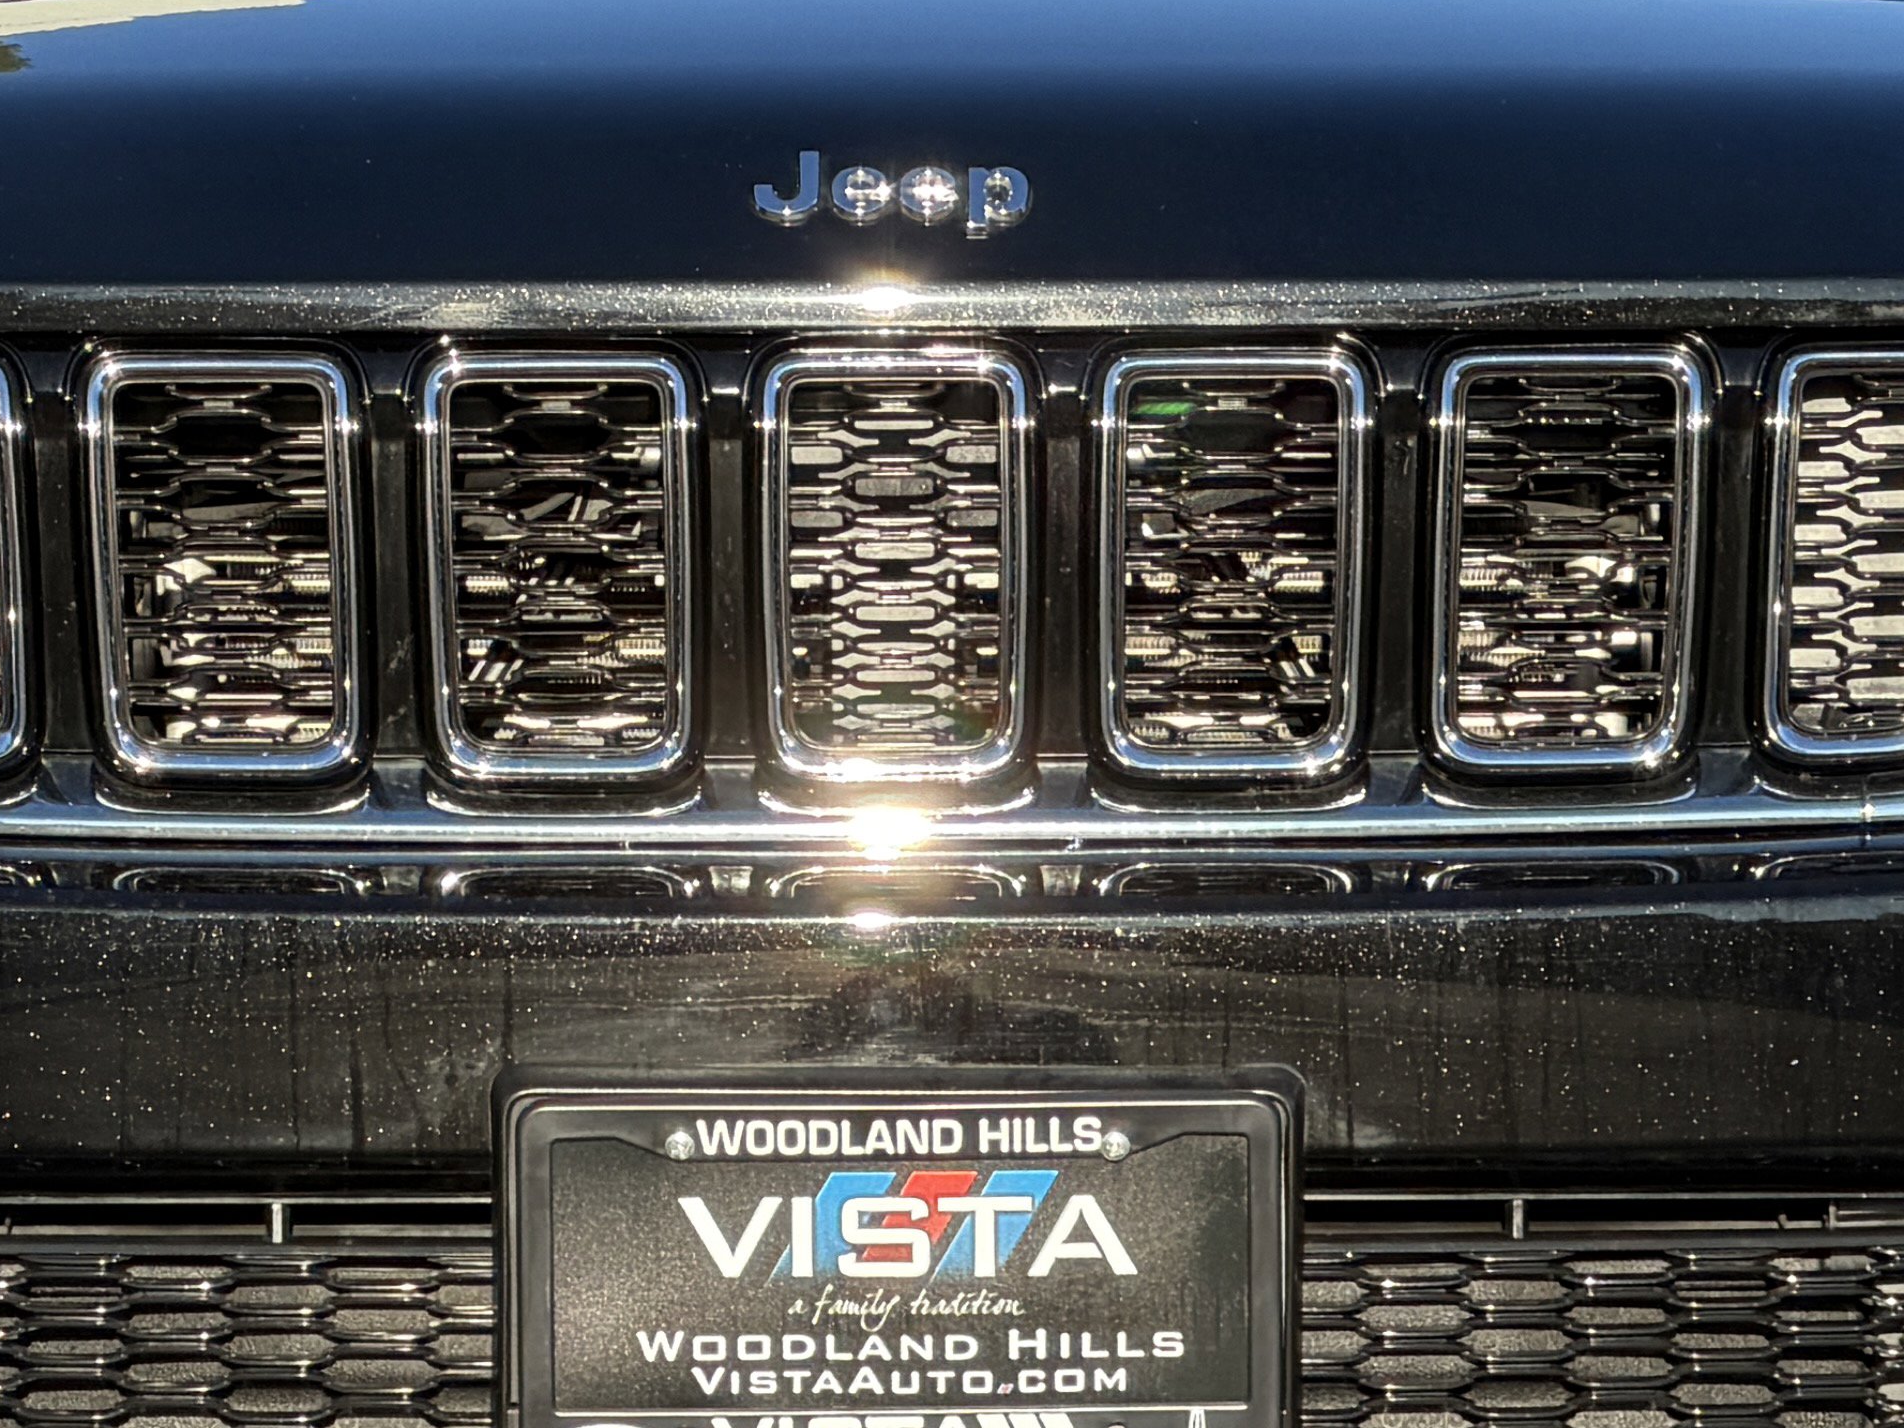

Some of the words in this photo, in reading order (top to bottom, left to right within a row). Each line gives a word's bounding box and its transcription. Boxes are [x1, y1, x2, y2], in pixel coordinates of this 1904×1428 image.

[754, 150, 1032, 239] Jeep
[696, 1119, 963, 1156] WOODLAND
[979, 1116, 1103, 1154] HILLS
[678, 1195, 1139, 1278] VISTA
[787, 1299, 808, 1315] a
[811, 1283, 901, 1332] family
[910, 1288, 1026, 1316] tradition
[636, 1330, 980, 1362] WOODLAND
[1008, 1329, 1185, 1360] HILLS
